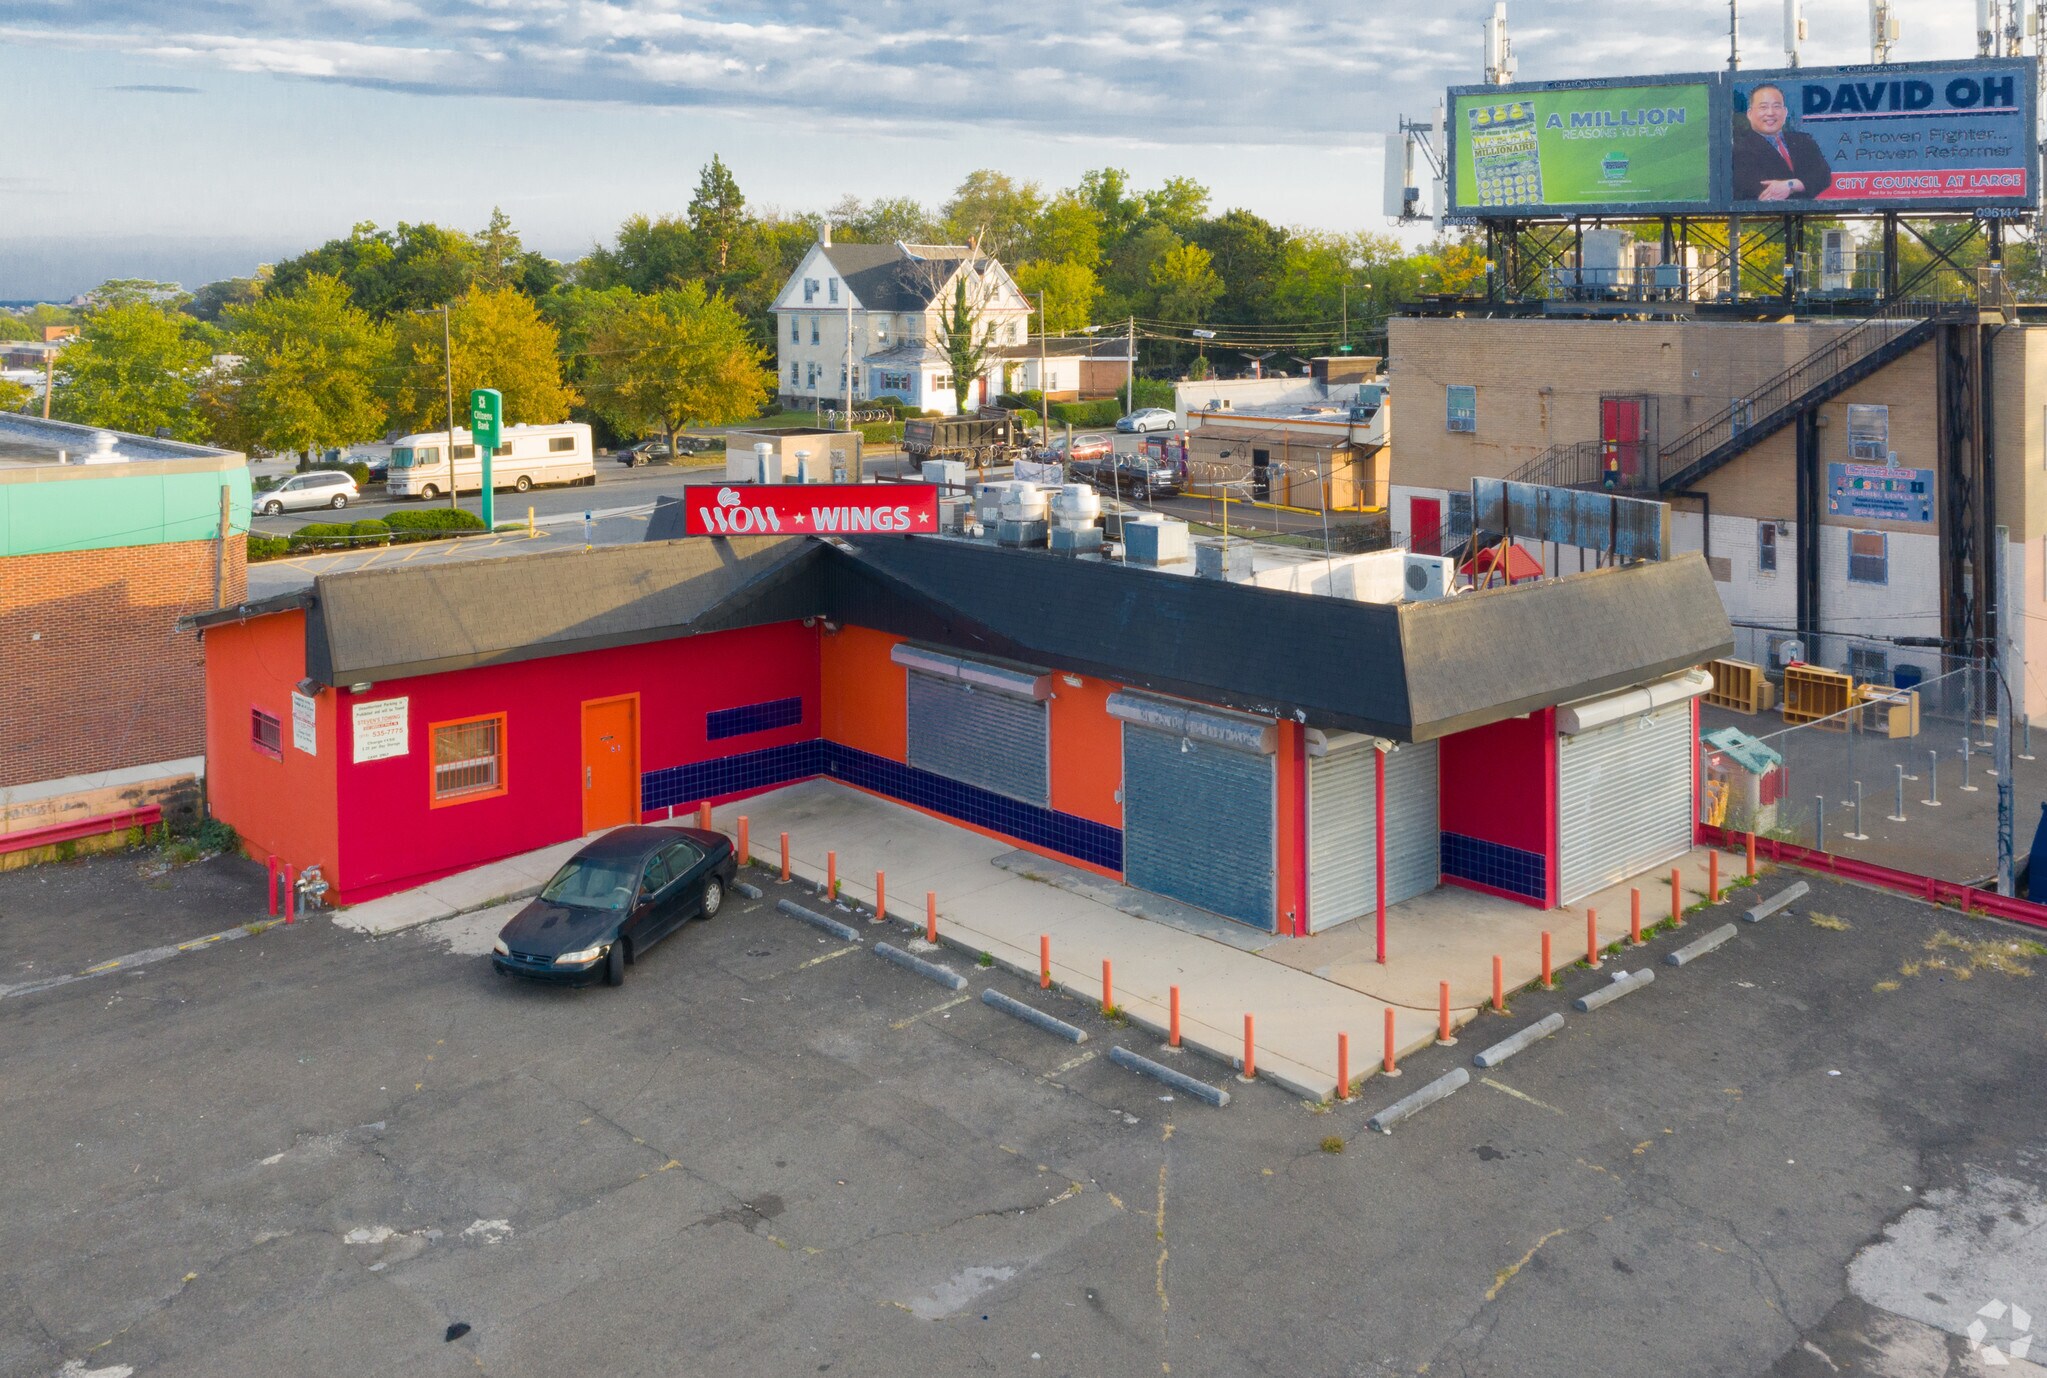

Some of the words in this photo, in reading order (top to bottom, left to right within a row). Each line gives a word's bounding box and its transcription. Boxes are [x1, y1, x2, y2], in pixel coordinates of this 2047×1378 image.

[1802, 80, 1934, 114] DAVID
[1946, 76, 2014, 108] OH
[1545, 113, 1564, 129] A
[1570, 107, 1686, 128] MILLION
[1562, 128, 1617, 140] REASONS
[1620, 127, 1636, 137] TO
[1639, 126, 1668, 137] PLAY
[1838, 132, 1852, 145] A
[1859, 130, 1921, 144] Proven
[1475, 142, 1536, 158] MILLIONAIRE
[1834, 149, 1848, 161] A
[1855, 147, 1919, 161] Proven
[1924, 145, 2013, 159] Reformer
[1836, 177, 1868, 190] CITY
[1873, 175, 1941, 189] COUNCIL
[1946, 174, 1965, 187] AT
[1970, 173, 2021, 187] LARGE
[1975, 207, 2021, 218] 096144
[1443, 216, 1478, 226] 096143
[474, 410, 493, 421] Citizens
[478, 421, 489, 430] Bank
[700, 506, 781, 533] WOW
[811, 506, 911, 531] WINGS
